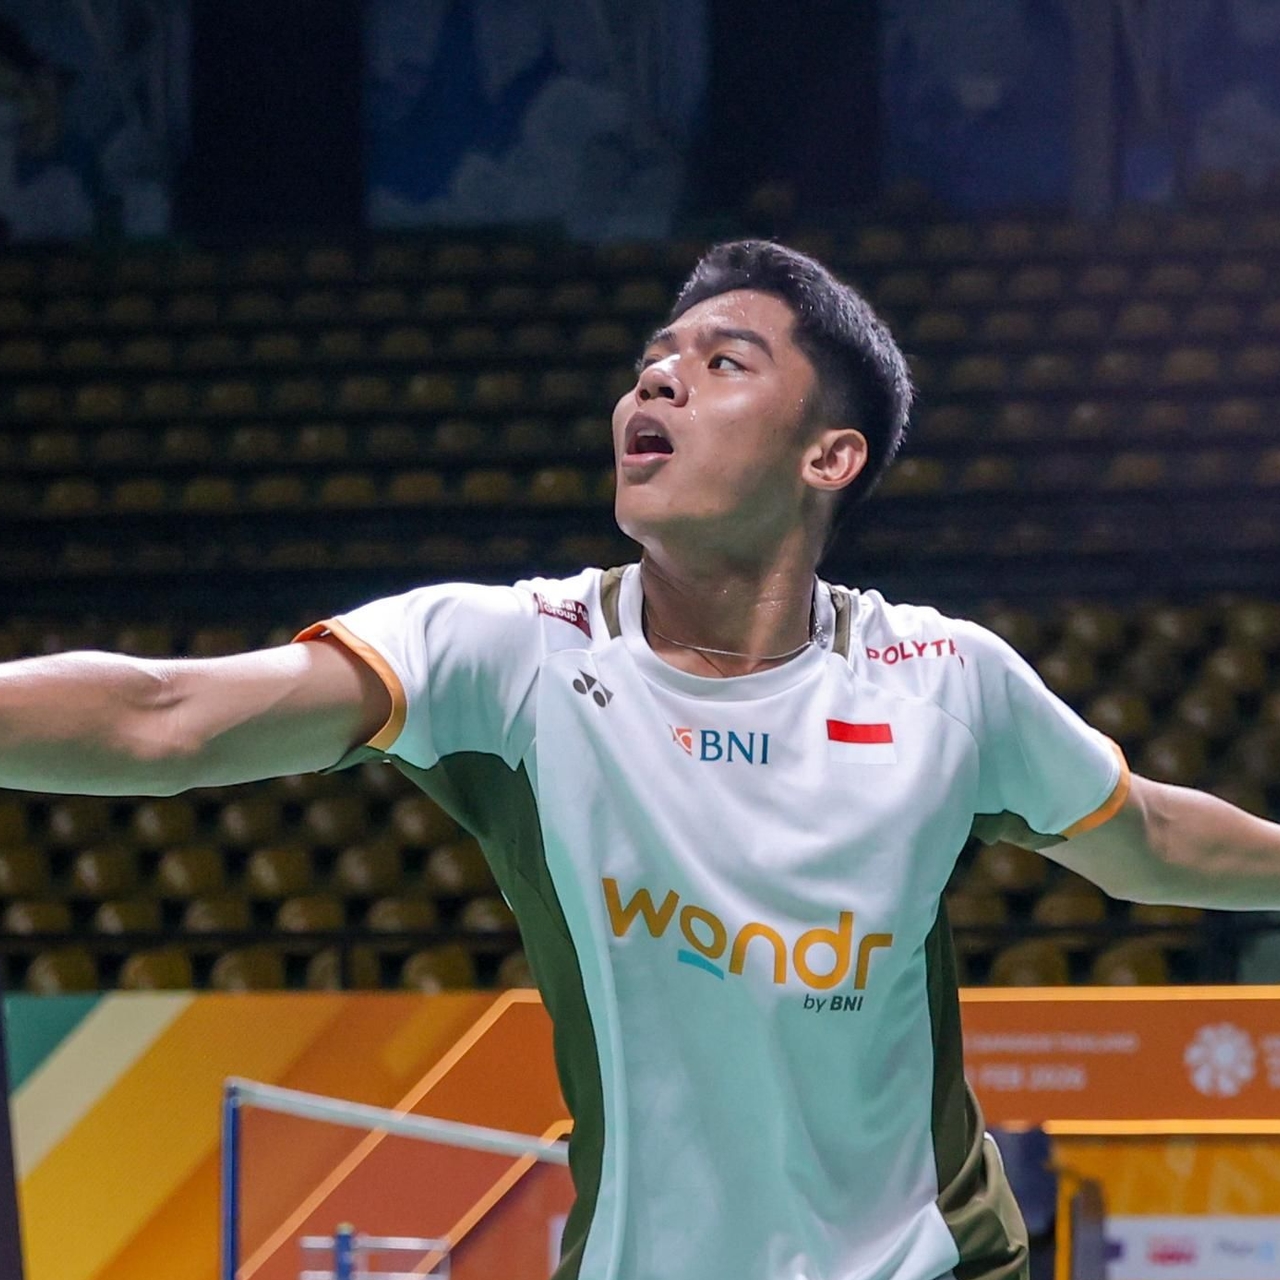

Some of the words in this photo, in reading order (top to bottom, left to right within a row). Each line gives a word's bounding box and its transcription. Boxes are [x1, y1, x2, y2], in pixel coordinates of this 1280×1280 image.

[865, 638, 964, 668] POLYT
[699, 729, 769, 765] BNI
[602, 877, 893, 991] wondr
[803, 993, 827, 1013] by
[830, 995, 864, 1012] BNI
